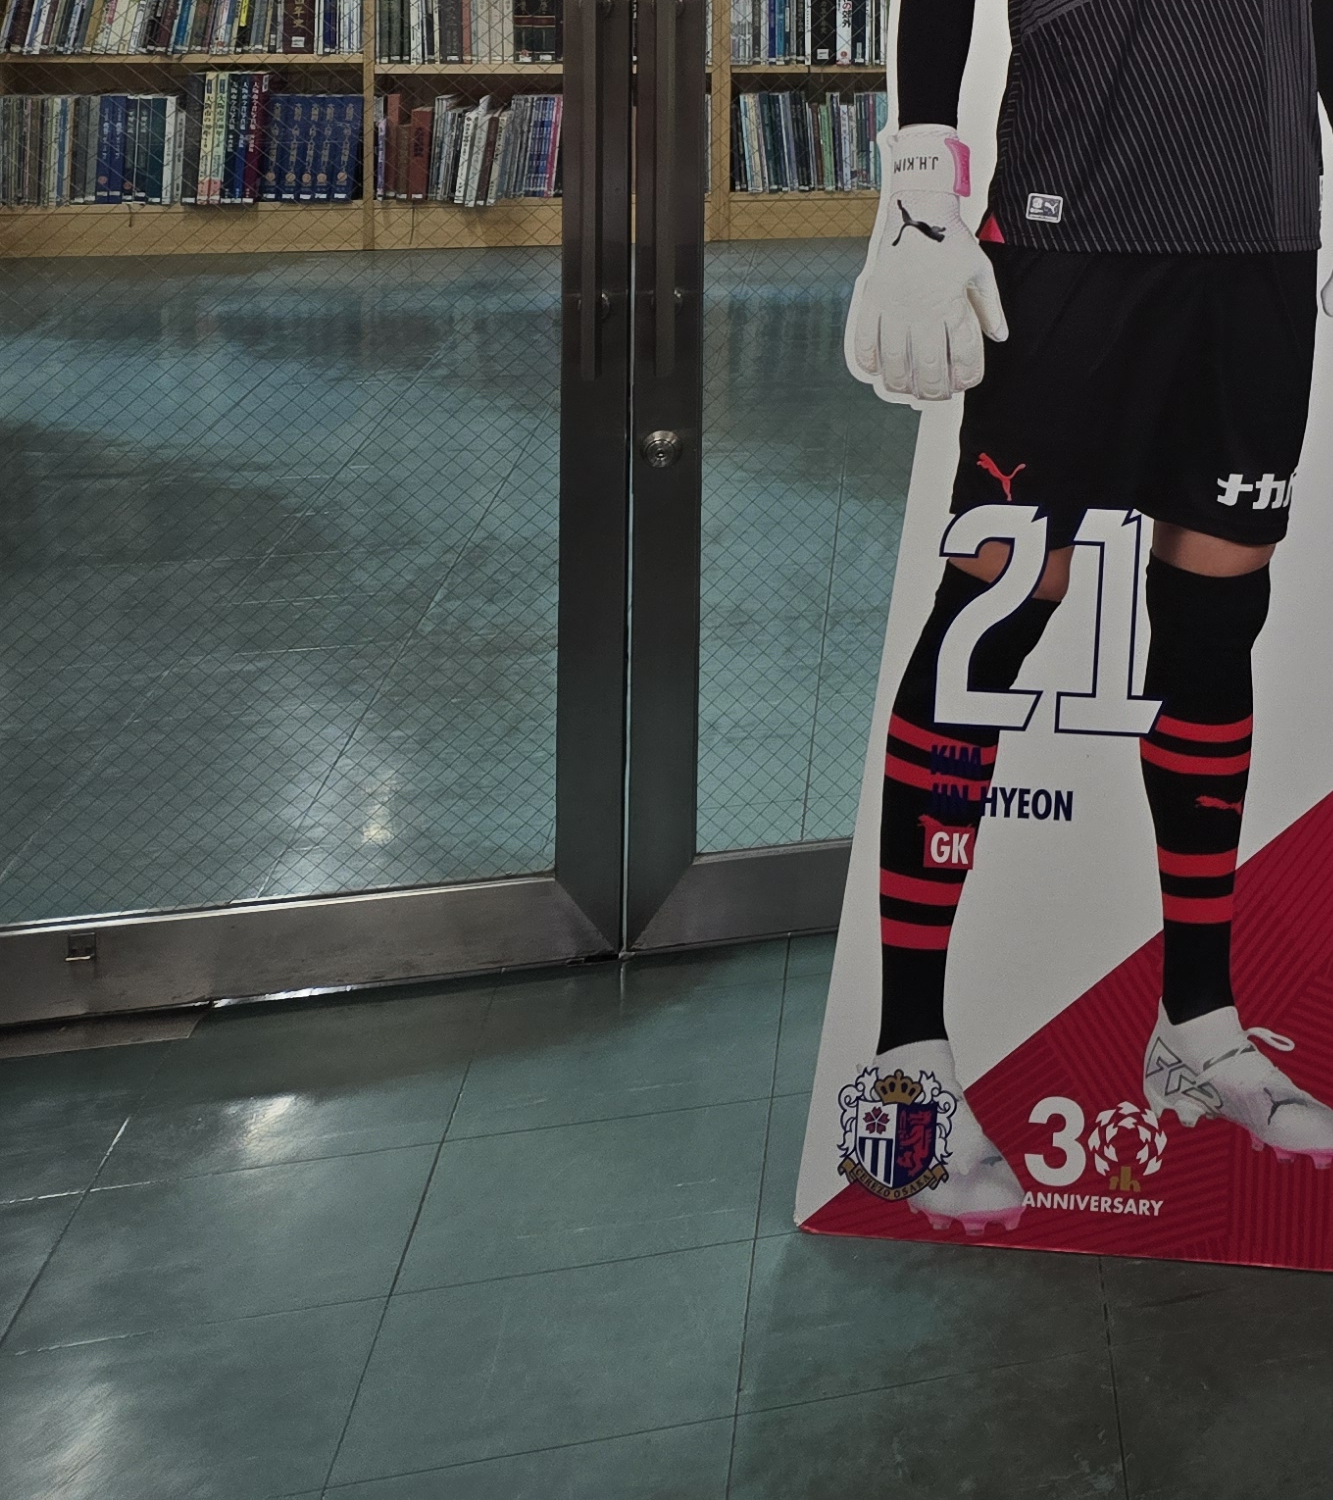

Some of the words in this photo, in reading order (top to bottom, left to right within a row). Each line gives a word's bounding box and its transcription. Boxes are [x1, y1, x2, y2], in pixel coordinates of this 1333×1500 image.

[934, 503, 1164, 737] 21
[980, 786, 1074, 822] HYEON
[930, 831, 970, 865] GK
[893, 1172, 930, 1198] OSAKA
[1021, 1191, 1164, 1217] ANNIVERSARY
